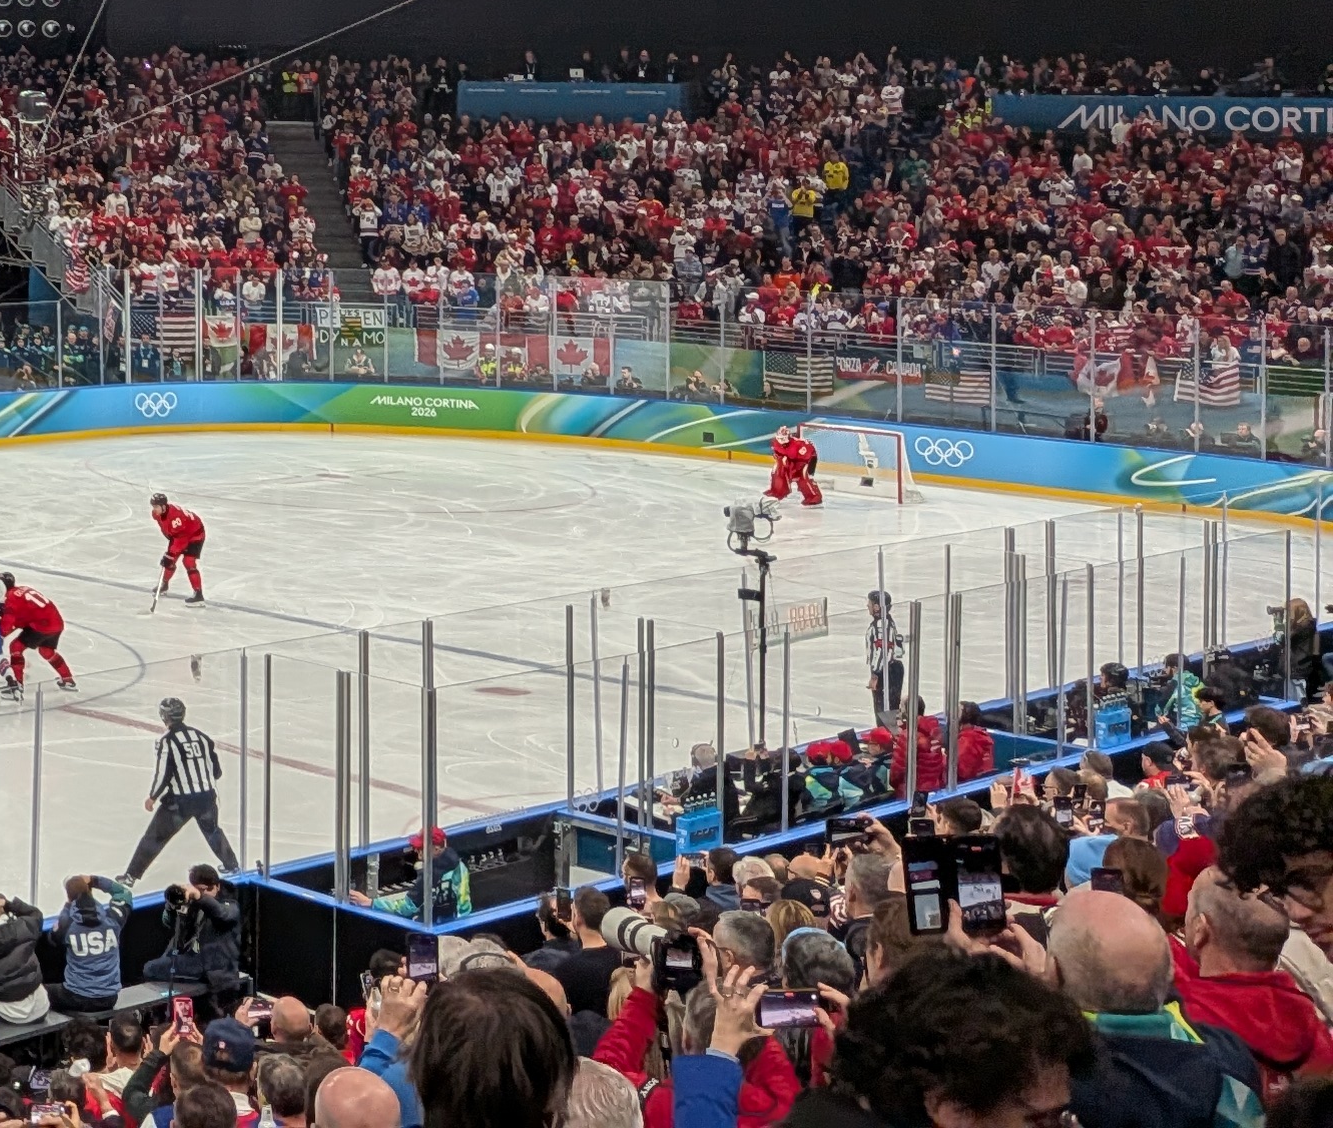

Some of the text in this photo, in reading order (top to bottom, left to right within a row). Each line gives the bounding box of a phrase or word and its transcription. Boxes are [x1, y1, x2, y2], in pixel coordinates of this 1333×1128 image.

[370, 395, 480, 410] MILANO CORTINA
[411, 407, 437, 417] 2026
[185, 742, 202, 759] 50
[69, 928, 119, 957] USA
